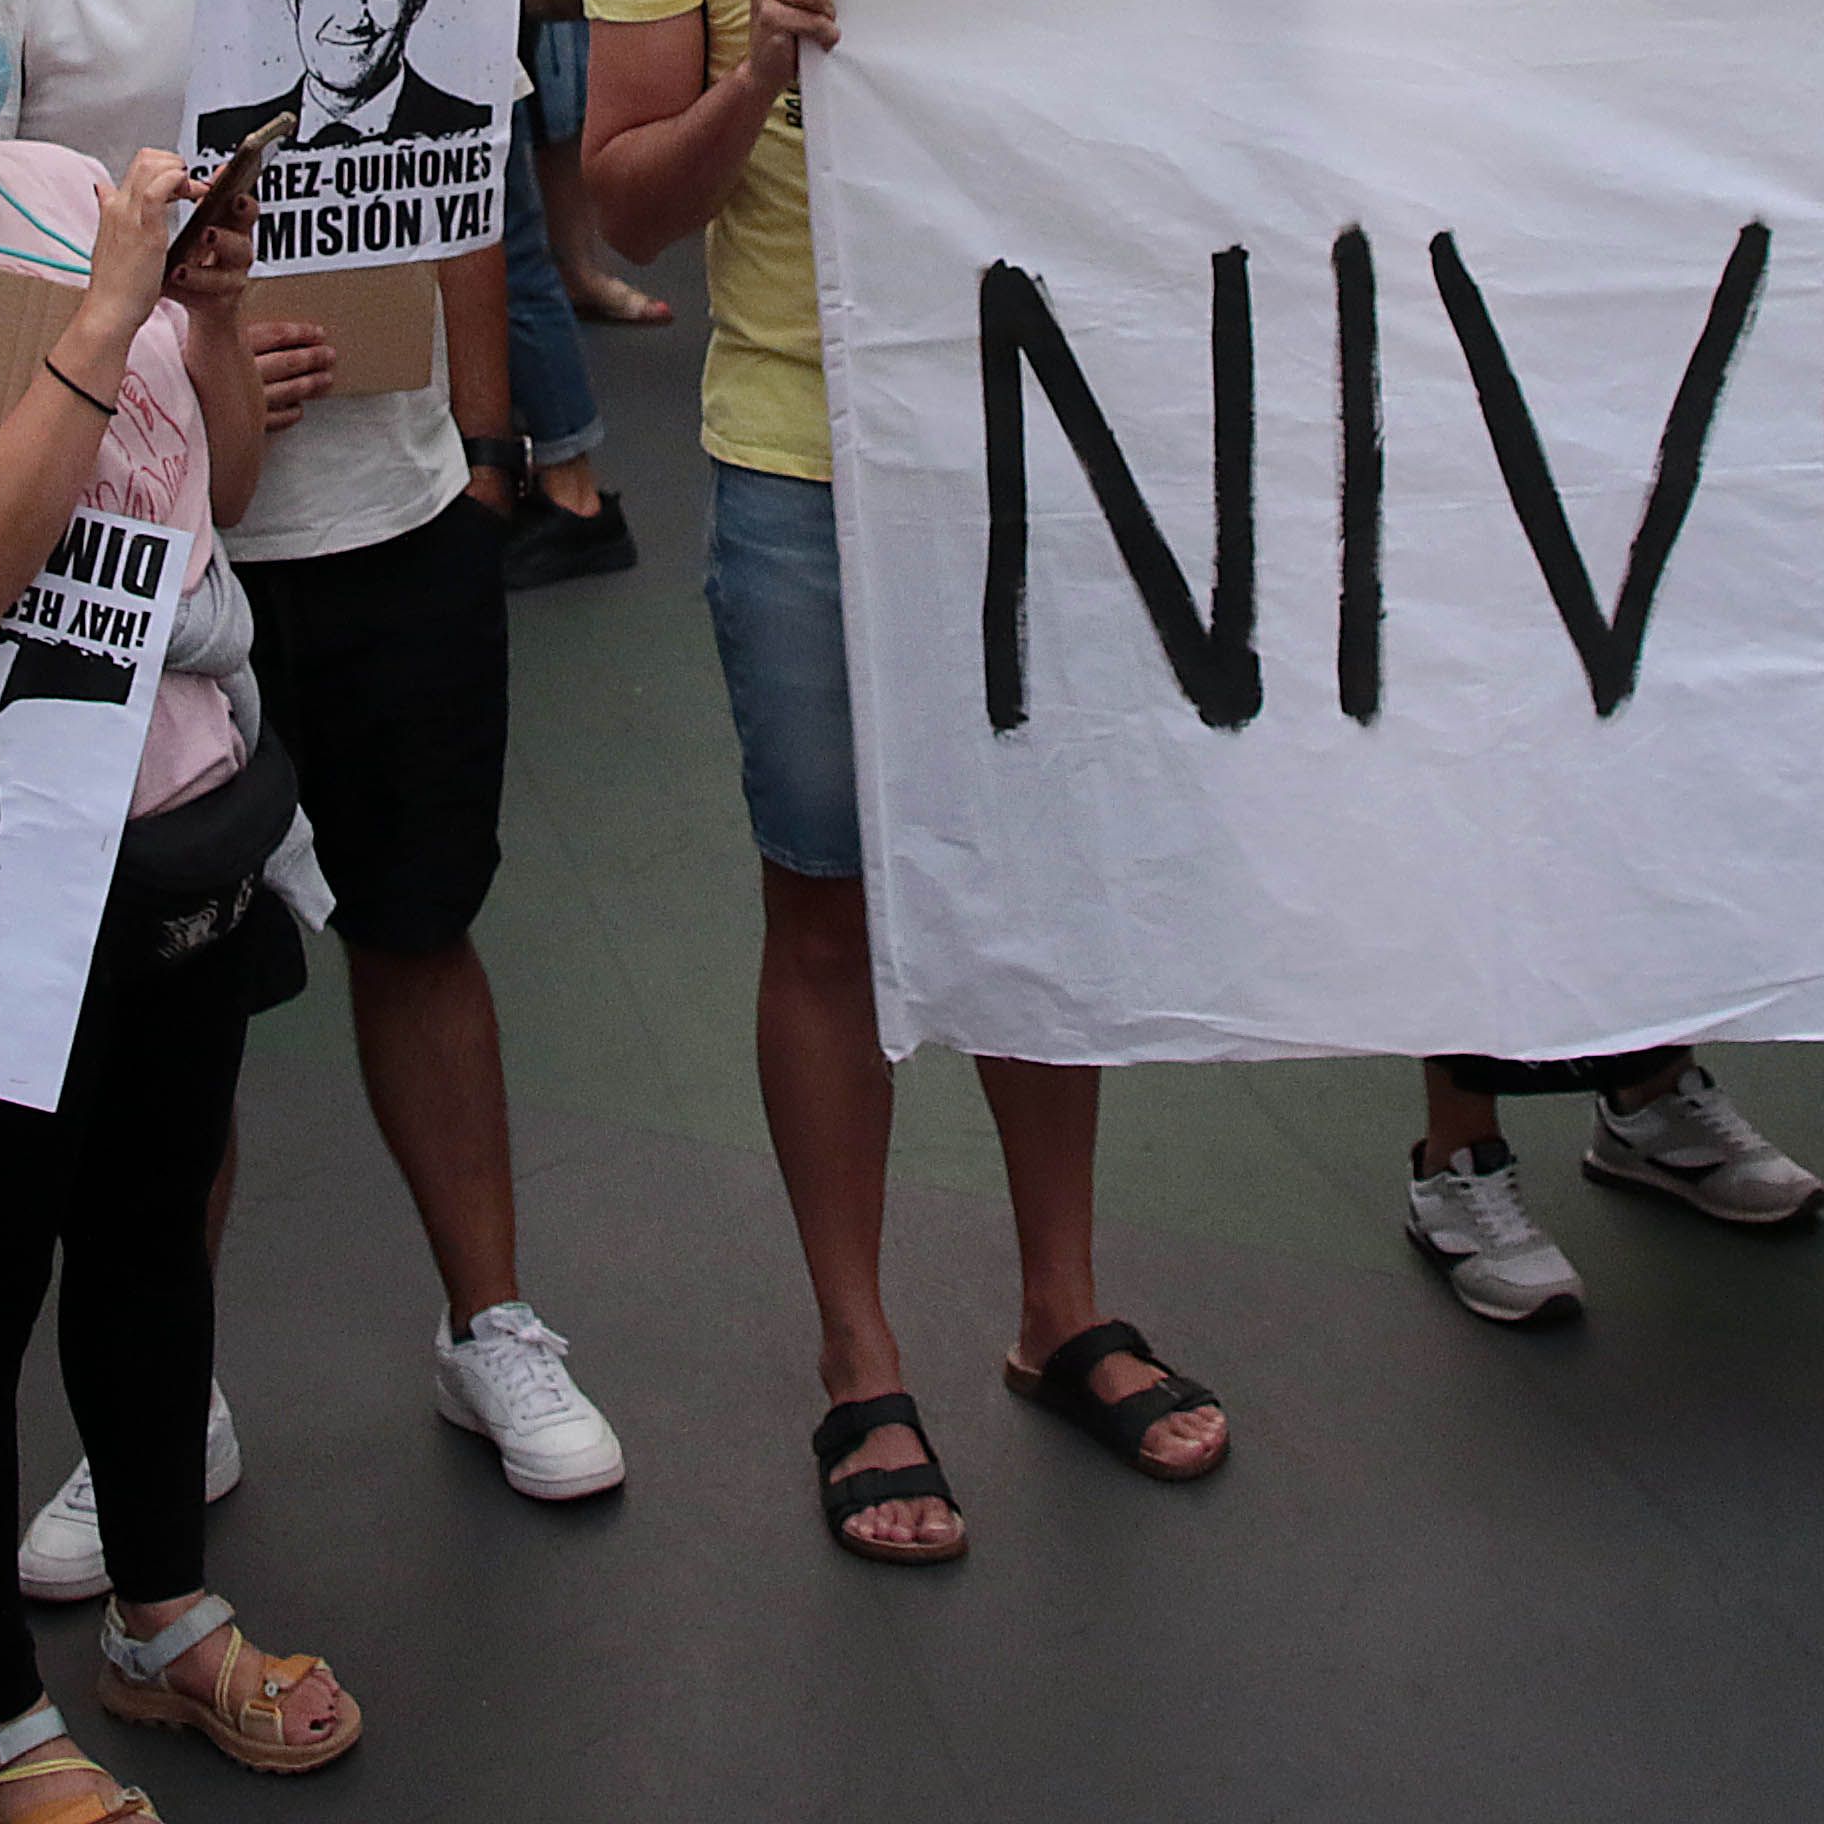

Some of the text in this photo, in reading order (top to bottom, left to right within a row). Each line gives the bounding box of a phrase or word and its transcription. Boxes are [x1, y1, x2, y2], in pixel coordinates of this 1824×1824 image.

[257, 188, 494, 262] MISIÓN YA!
[67, 599, 152, 648] ¡HAY
